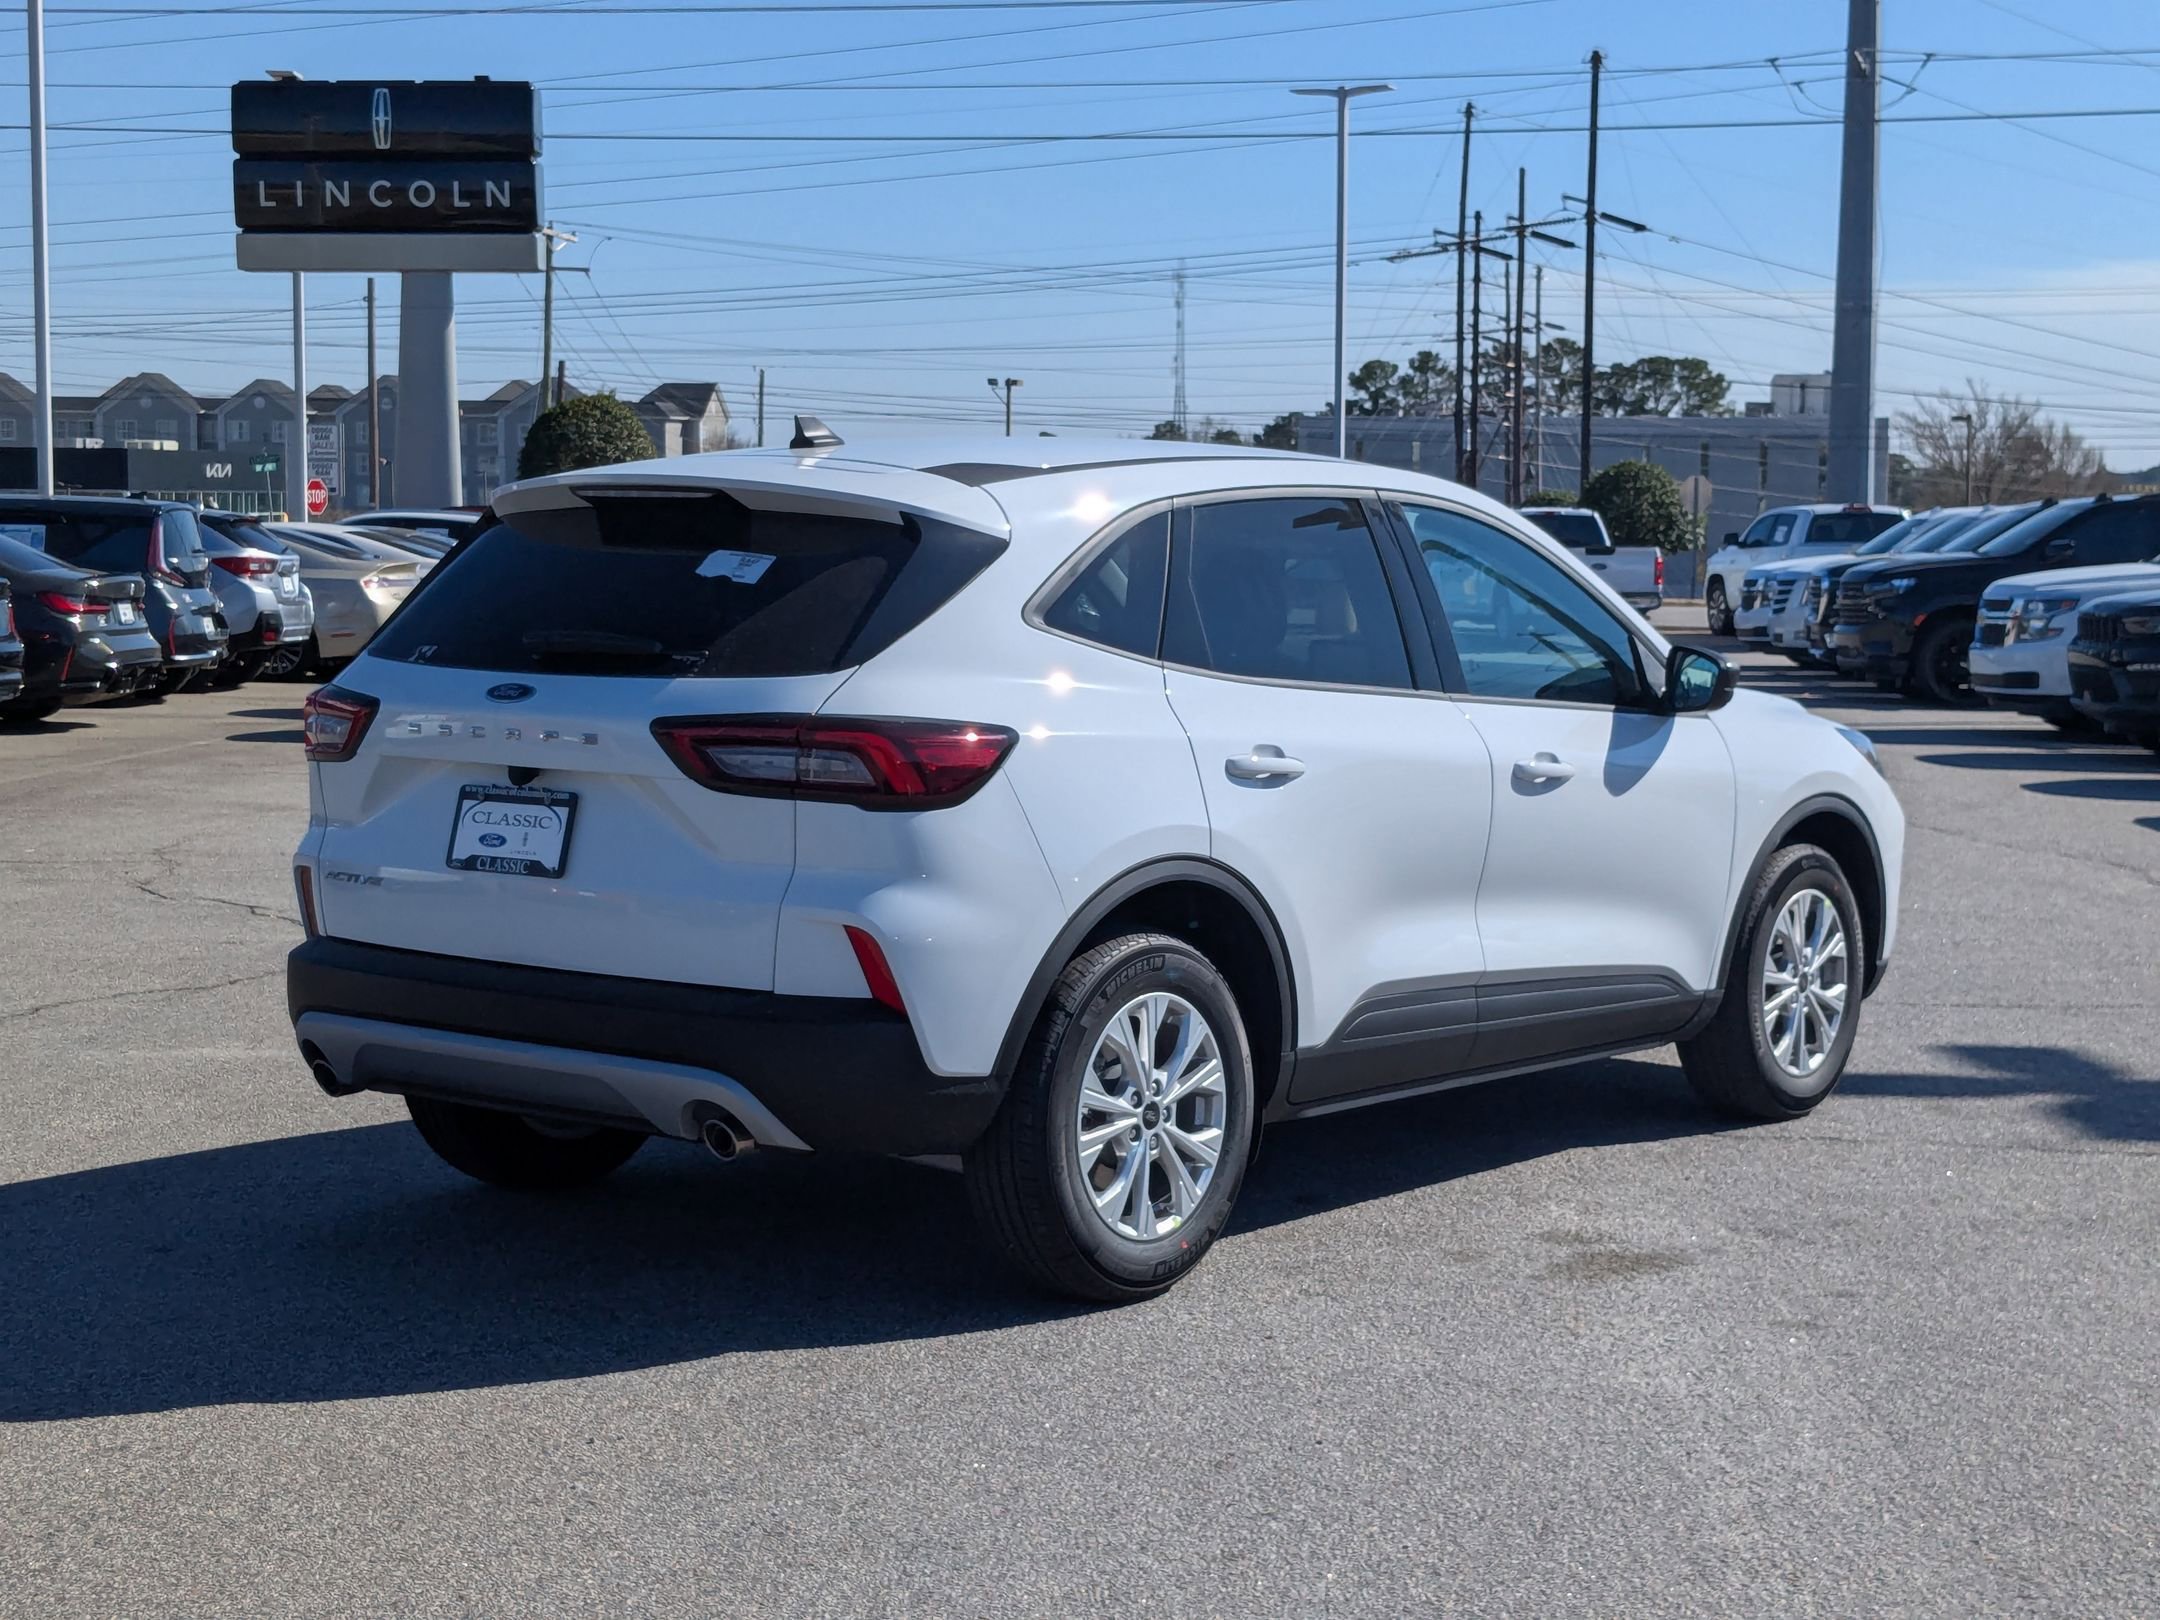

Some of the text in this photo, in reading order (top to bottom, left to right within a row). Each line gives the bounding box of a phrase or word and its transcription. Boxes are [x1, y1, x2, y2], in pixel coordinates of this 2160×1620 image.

[258, 180, 511, 208] LINCOLN
[206, 463, 232, 478] KIA
[307, 490, 326, 504] STOP
[407, 722, 599, 746] ESCAPE
[472, 811, 553, 829] CLASSIC
[476, 856, 531, 874] CLASSIC
[1105, 956, 1164, 998] MICHELIN
